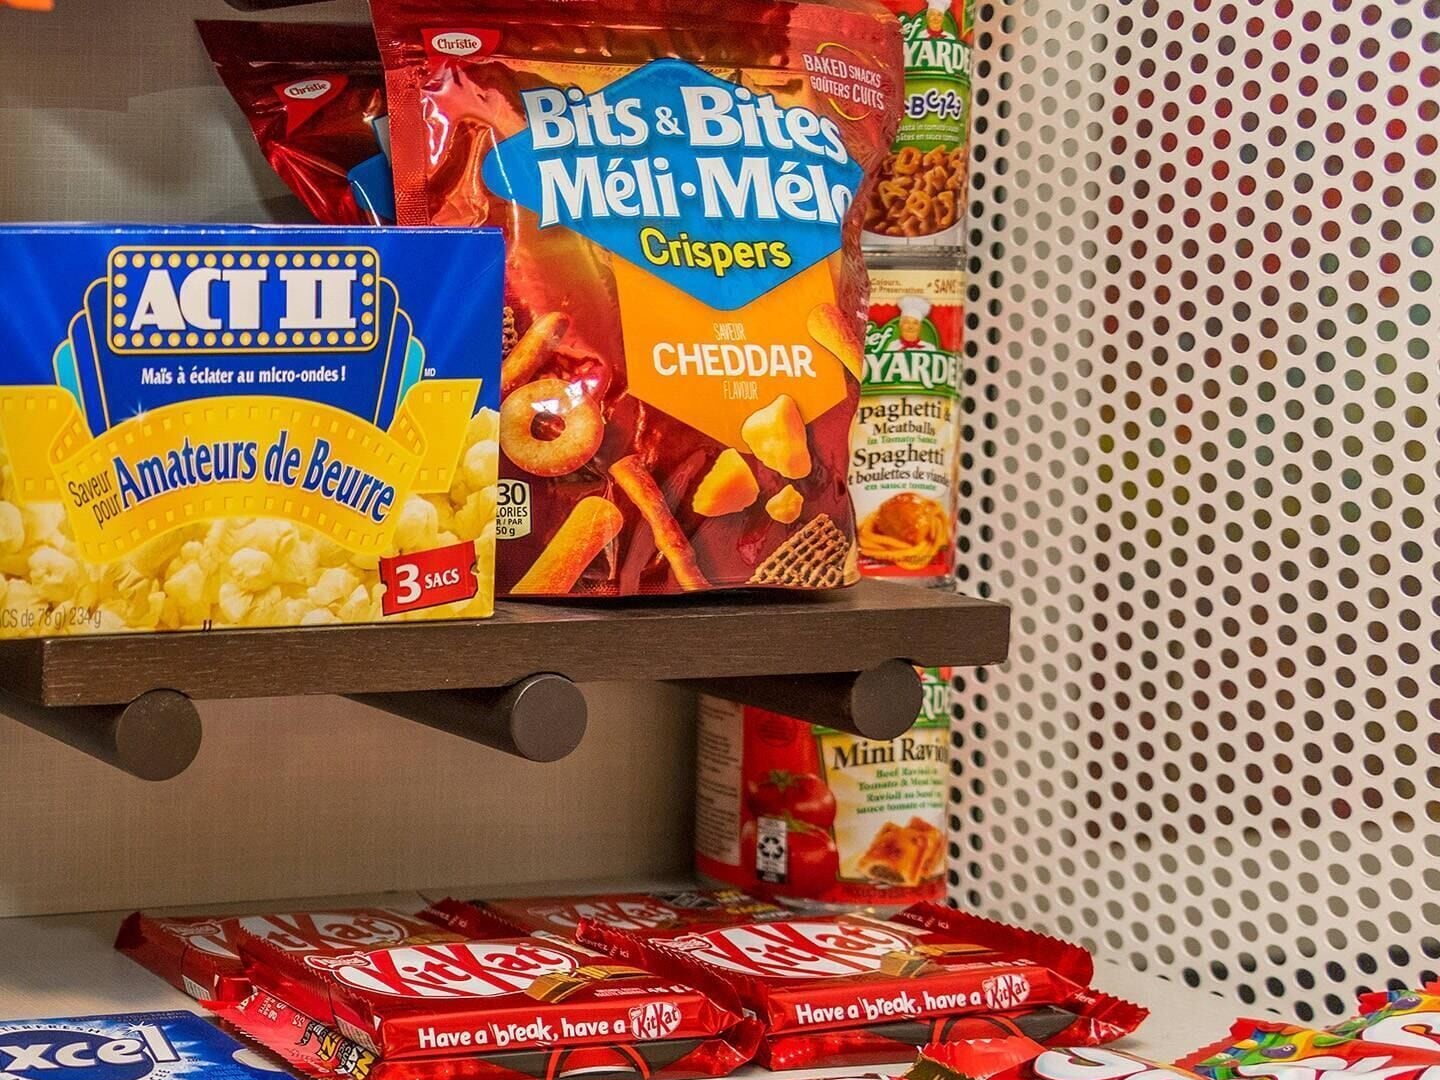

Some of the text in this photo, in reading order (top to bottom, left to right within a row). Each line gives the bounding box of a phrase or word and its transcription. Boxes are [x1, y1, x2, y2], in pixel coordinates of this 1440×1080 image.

[437, 38, 478, 50] Christie
[802, 54, 881, 88] BAKED SNACKS
[289, 82, 328, 97] Christie
[810, 75, 885, 110] GOÛTERS CUITS
[522, 86, 848, 164] Bits & Bites
[640, 227, 792, 277] Crispers
[130, 268, 357, 331] ACT II
[713, 322, 746, 341] SAVEUR
[142, 366, 255, 384] Maïs à éclater au
[424, 368, 436, 377] MD
[652, 342, 817, 378] CHEDDAR
[723, 380, 758, 400] FLAVOUR
[857, 397, 942, 424] paghetti
[872, 420, 936, 436] Meatballs
[852, 443, 945, 470] Spaghetti
[68, 468, 113, 507] Saveur
[112, 431, 395, 524] Amateurs de Beurre
[855, 466, 924, 484] boulettes de
[93, 494, 123, 530] pour
[394, 564, 460, 604] 3 SACS
[21, 607, 34, 627] de
[69, 605, 91, 626] 234
[92, 610, 102, 628] g
[832, 741, 895, 770] Mini
[365, 942, 570, 998] KitKat
[795, 976, 1029, 1024] Have a break, have a KitKat
[418, 1004, 679, 1049] Have a break, have a KitKat
